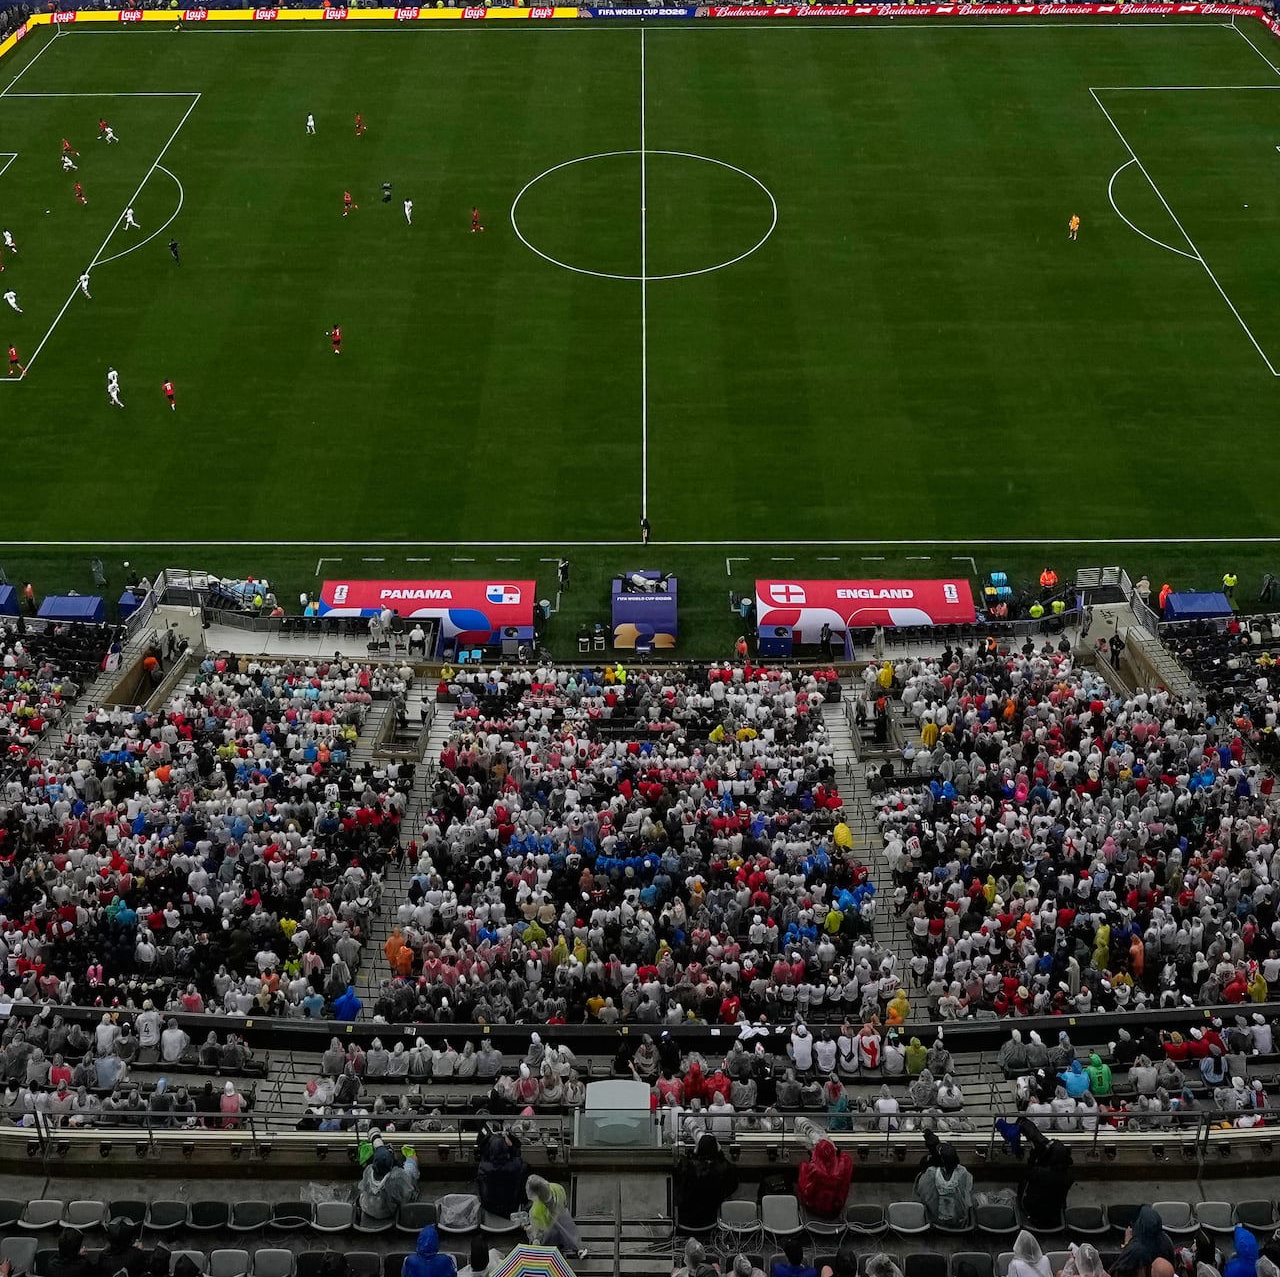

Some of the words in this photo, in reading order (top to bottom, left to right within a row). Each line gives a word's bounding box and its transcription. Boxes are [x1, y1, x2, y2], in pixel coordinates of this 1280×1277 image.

[119, 10, 142, 22] Lay's
[184, 9, 207, 21] Lay's
[255, 9, 277, 21] Lay's
[325, 8, 347, 20] Lay's
[397, 8, 419, 20] Lay's
[464, 7, 486, 19] Lay's
[531, 7, 553, 19] Lay's
[715, 7, 769, 17] Budweiser
[795, 7, 850, 17] Budweiser
[876, 6, 931, 16] Budweiser
[958, 5, 1012, 15] Budweiser
[1039, 5, 1092, 15] Budweiser
[1120, 5, 1173, 15] Budweiser
[1201, 4, 1257, 16] Budweiser
[52, 11, 75, 23] Lay's
[380, 590, 453, 599] PANAMA
[836, 589, 914, 599] ENGLAND
